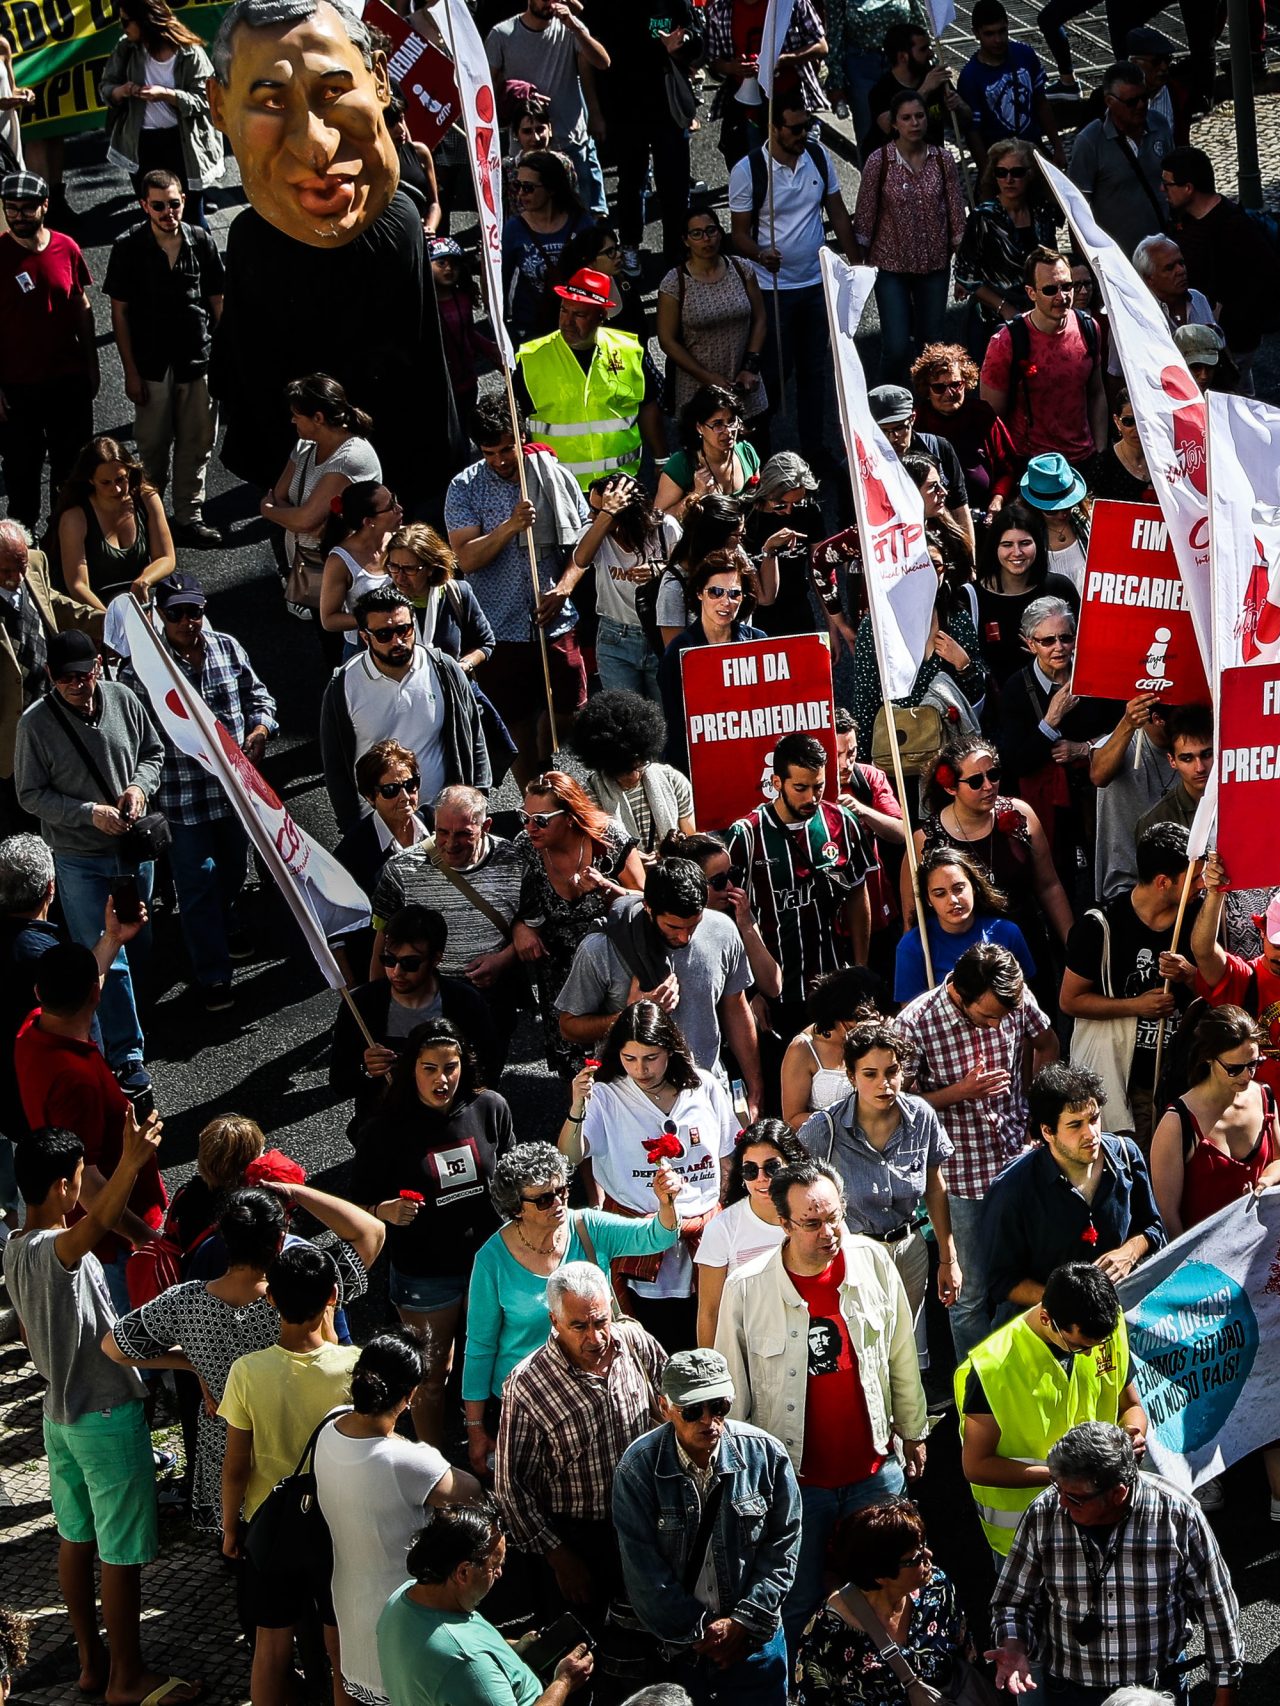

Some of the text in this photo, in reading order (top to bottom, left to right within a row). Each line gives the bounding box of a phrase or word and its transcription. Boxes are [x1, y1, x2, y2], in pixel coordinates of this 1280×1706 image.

[1131, 519, 1168, 552] FIM
[722, 652, 790, 687] FIM DA
[1135, 679, 1174, 691] CGTP
[690, 700, 831, 744] PRECARIEDADE
[447, 1158, 466, 1177] DC
[1129, 1286, 1231, 1356] SOMOS JOVENS!
[1192, 1320, 1246, 1367] FUTURO
[1147, 1354, 1240, 1430] NO NOSSO PAÍS!
